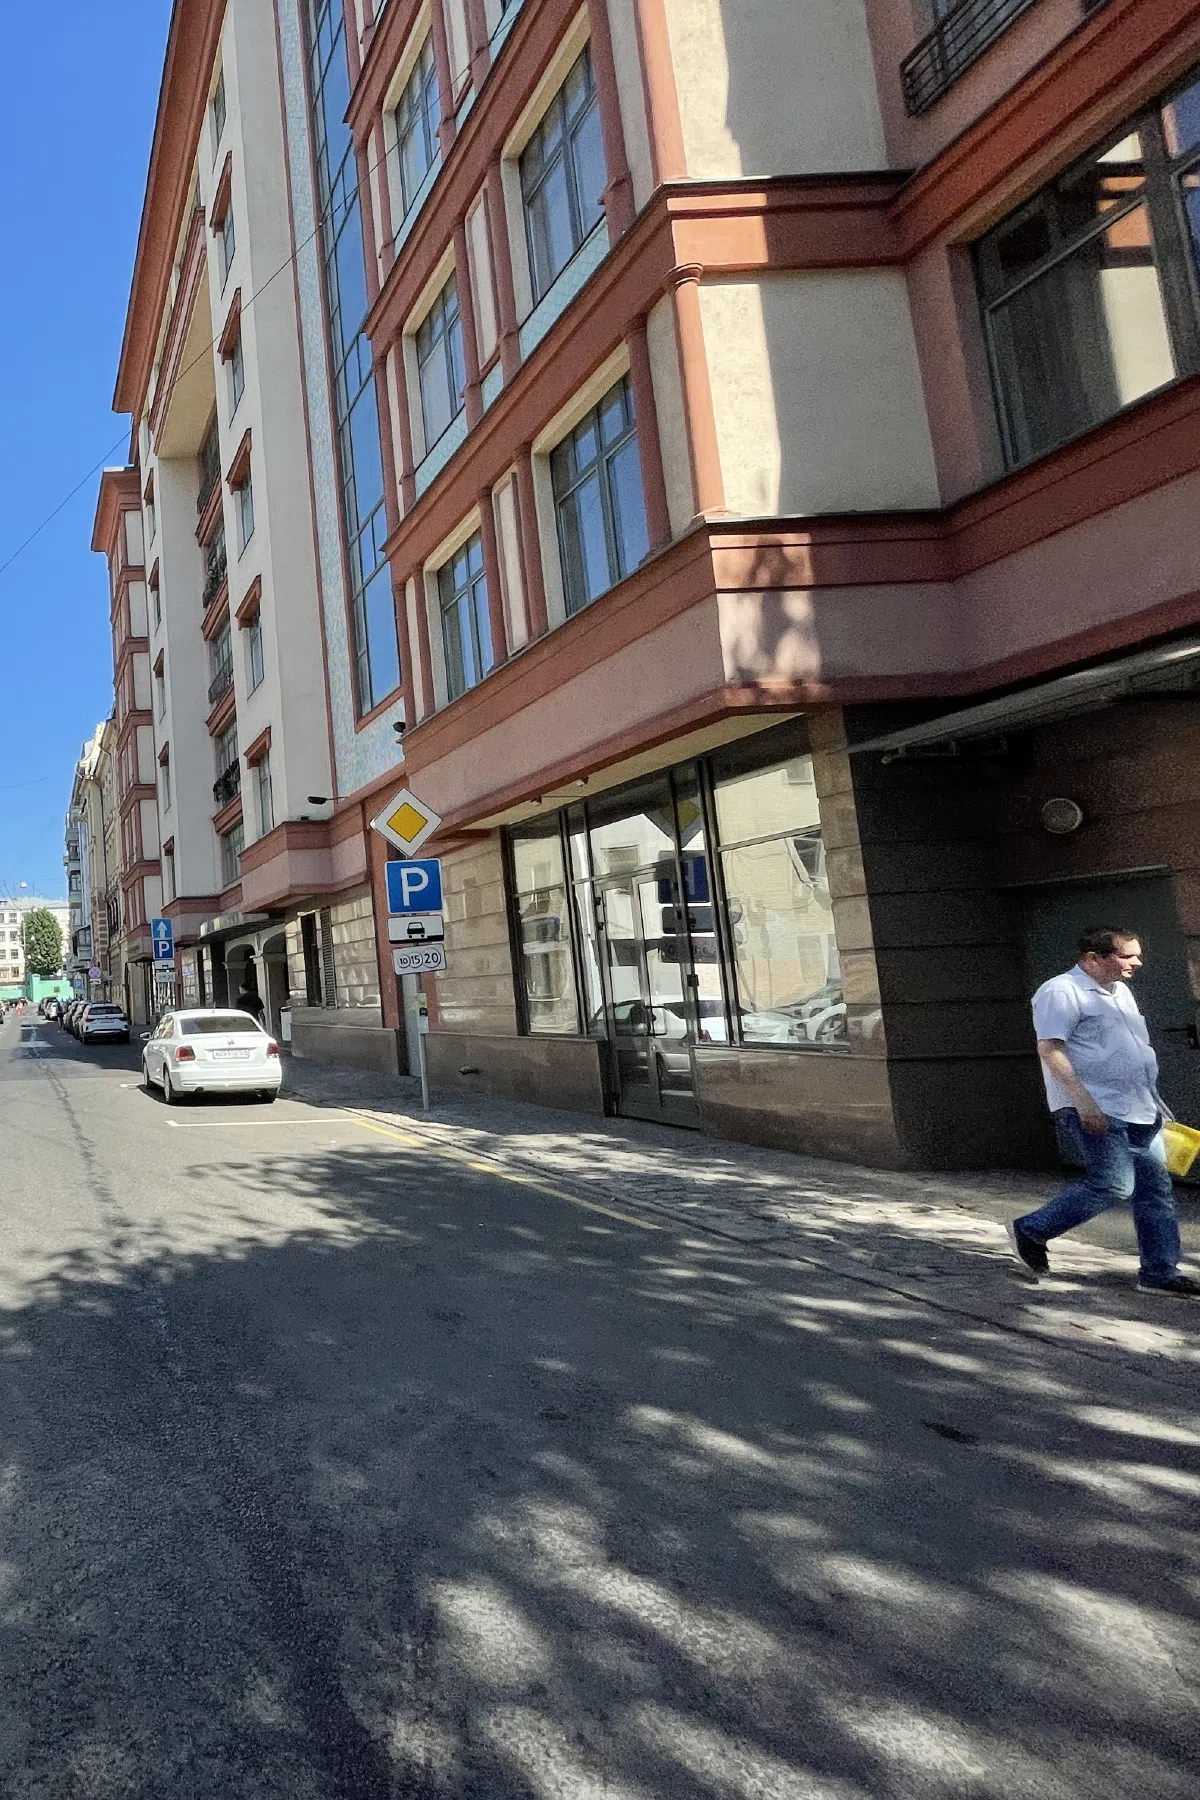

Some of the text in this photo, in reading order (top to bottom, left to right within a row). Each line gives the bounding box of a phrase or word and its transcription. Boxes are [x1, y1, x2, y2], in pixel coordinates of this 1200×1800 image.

[400, 867, 429, 907] P
[158, 941, 170, 957] P
[399, 952, 439, 965] 10 15 20
